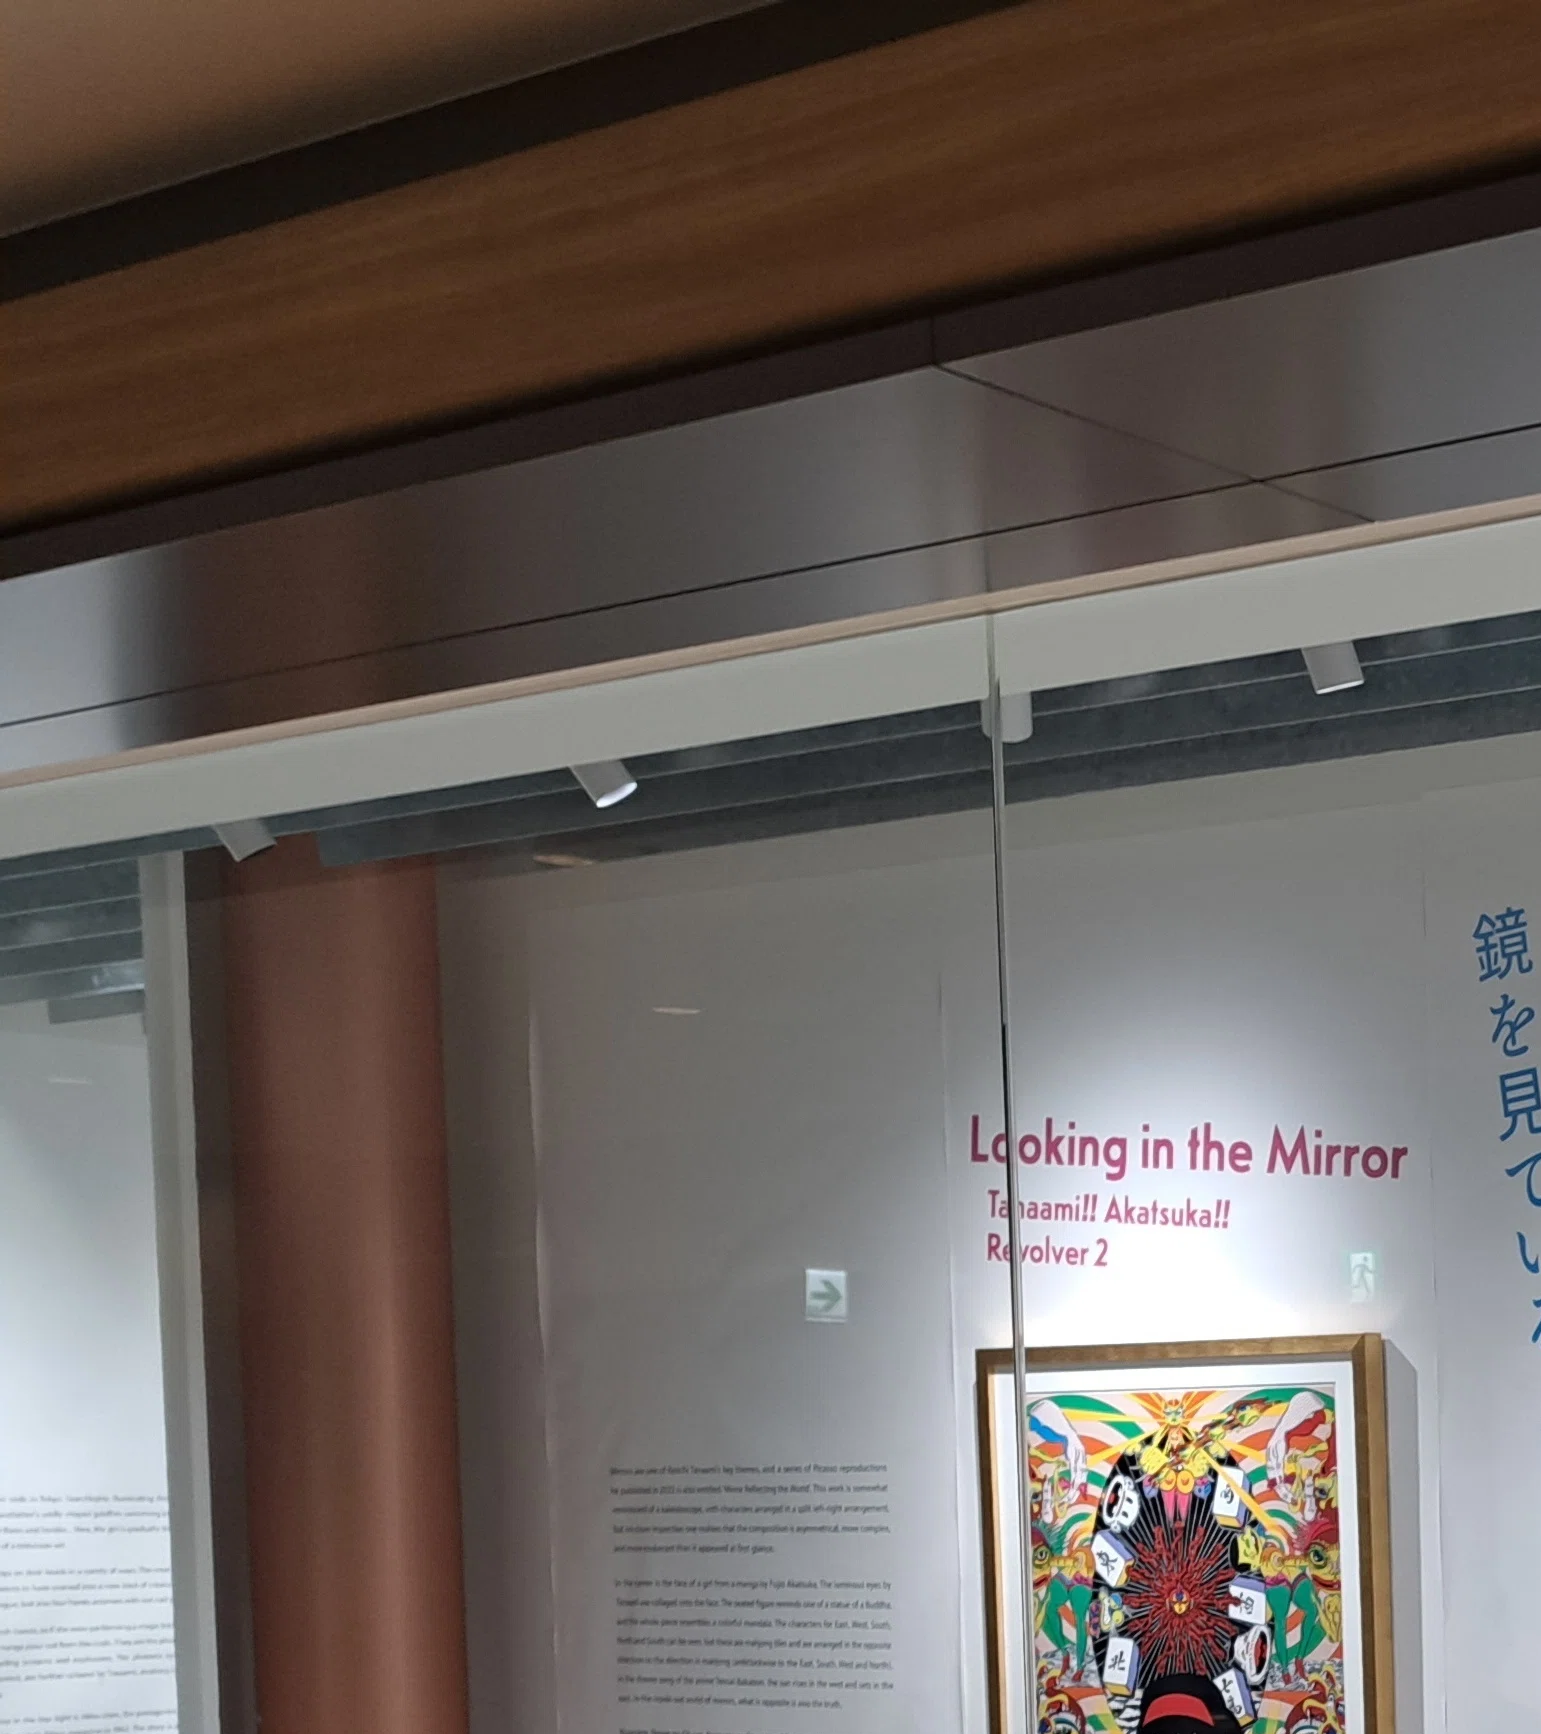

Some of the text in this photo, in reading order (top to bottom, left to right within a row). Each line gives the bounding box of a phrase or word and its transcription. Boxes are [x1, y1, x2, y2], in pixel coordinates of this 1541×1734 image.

[970, 1114, 1409, 1181] Looking in the Mirror
[1104, 1194, 1231, 1230] Akatsuka!!
[1094, 1238, 1109, 1267] 2
